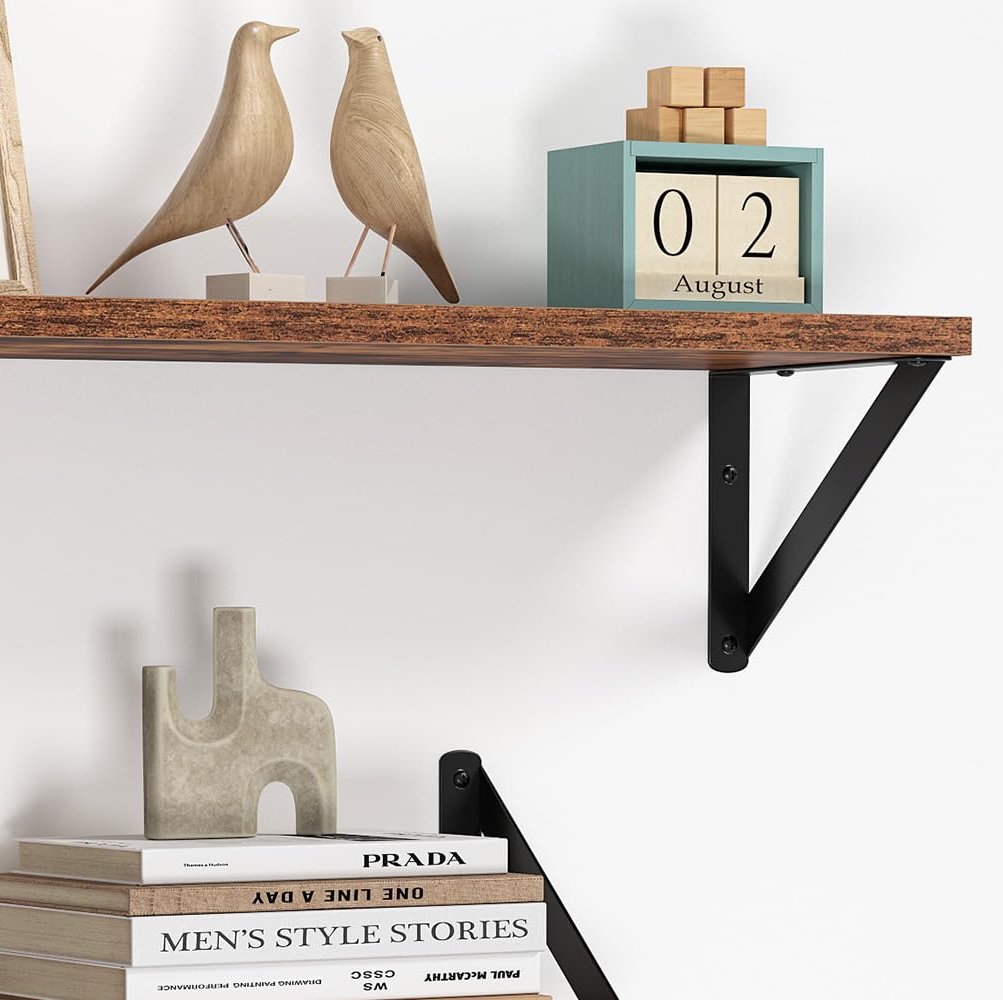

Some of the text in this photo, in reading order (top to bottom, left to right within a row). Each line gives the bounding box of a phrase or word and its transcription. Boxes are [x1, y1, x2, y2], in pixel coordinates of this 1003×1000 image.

[672, 274, 764, 300] August
[362, 851, 466, 868] PRADA
[252, 887, 424, 905] ONE LINE A DAY
[275, 925, 381, 949] STYLE
[390, 918, 529, 943] STORIES
[350, 969, 396, 980] CSSC
[423, 969, 521, 982] PAUL McCARTHY
[157, 978, 323, 992] DRAWING PAINTING PERFORMANCE
[363, 982, 388, 991] WS
